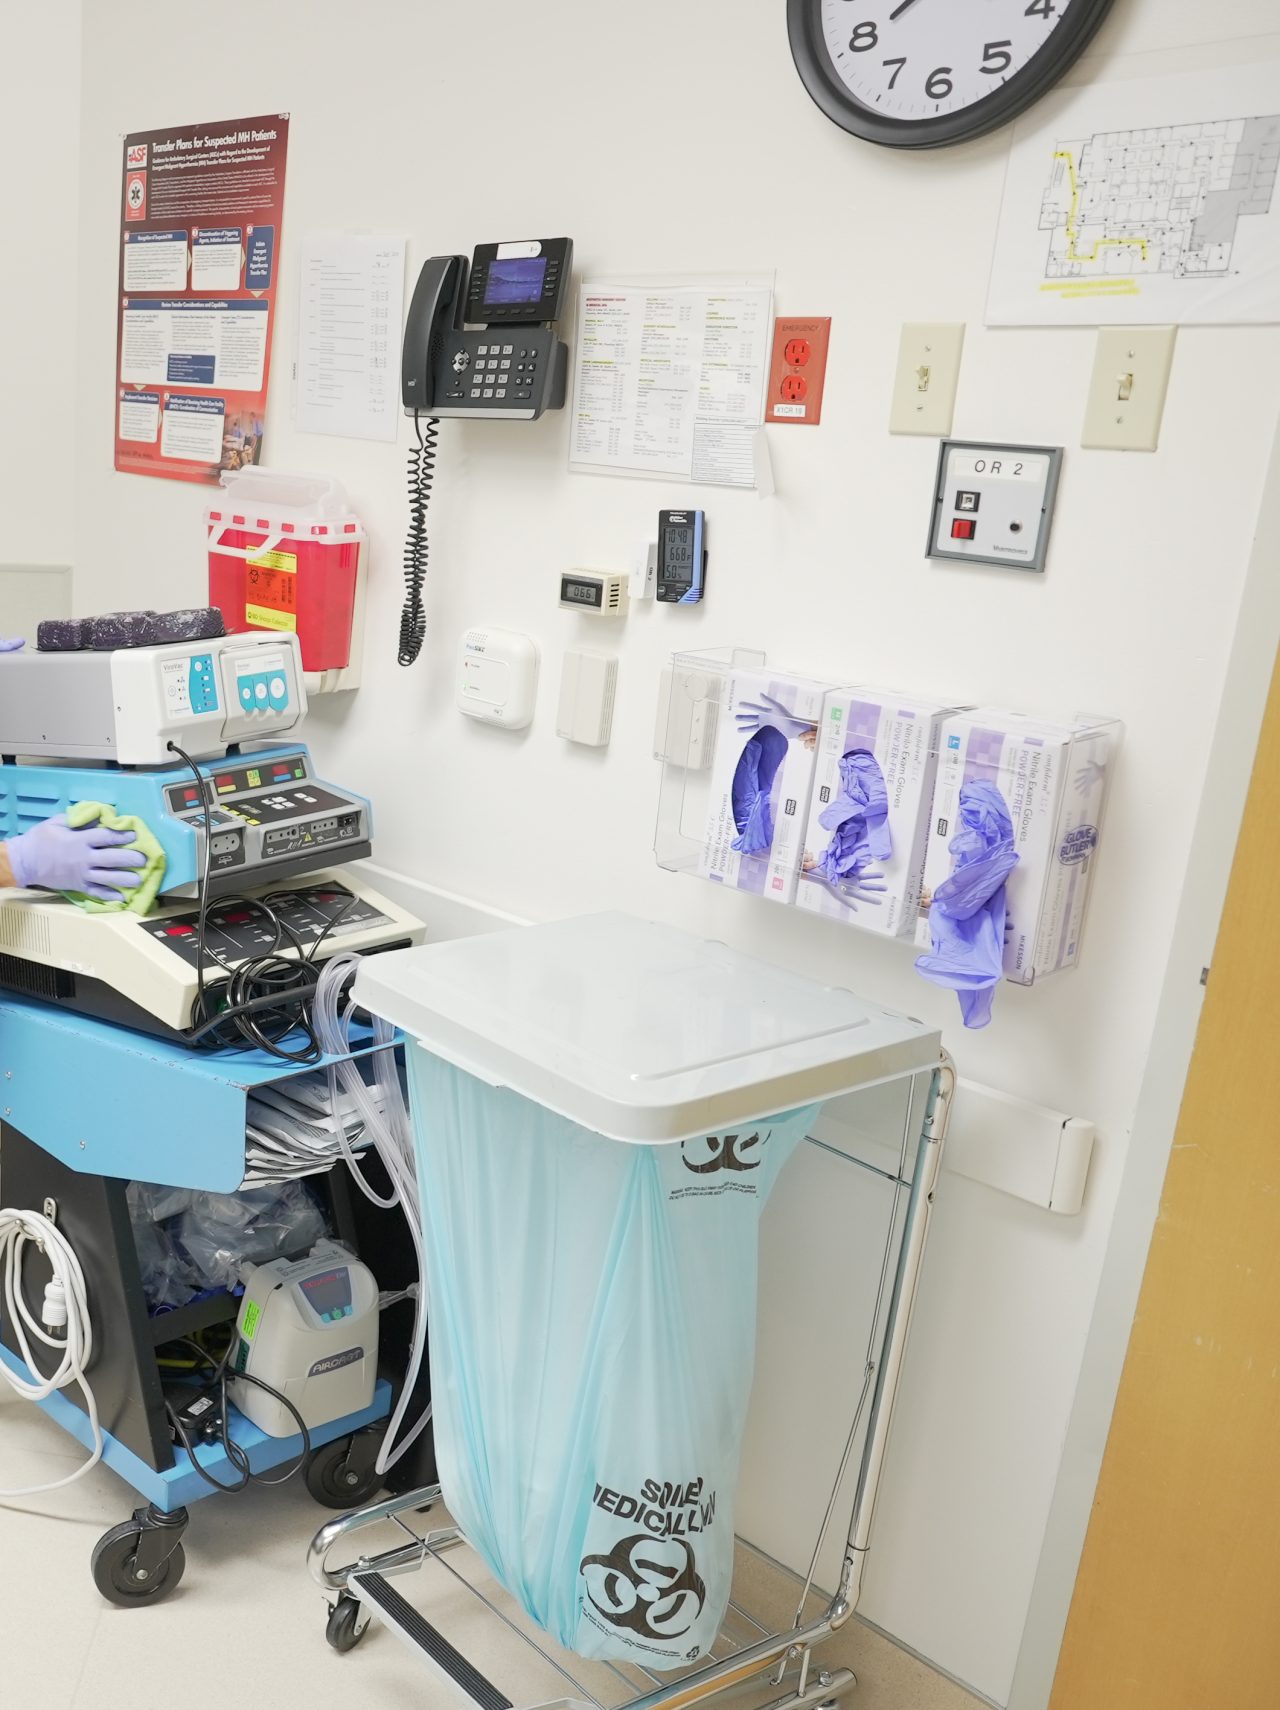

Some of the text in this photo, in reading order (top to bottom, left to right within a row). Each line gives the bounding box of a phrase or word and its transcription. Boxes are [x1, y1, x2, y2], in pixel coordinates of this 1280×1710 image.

[1024, 0, 1056, 20] 4
[848, 21, 878, 52] 8
[979, 40, 1013, 75] 5
[882, 57, 907, 90] 7
[924, 67, 953, 99] 6
[152, 129, 277, 153] Transfer Plans for Suspected MH Patients
[974, 459, 1023, 475] OR 2
[900, 751, 910, 774] Exam
[894, 776, 906, 809] Gloves
[1020, 752, 1041, 842] Nitrile Exam Gloves
[715, 825, 725, 848] Exam
[1065, 827, 1092, 843] GLOVE
